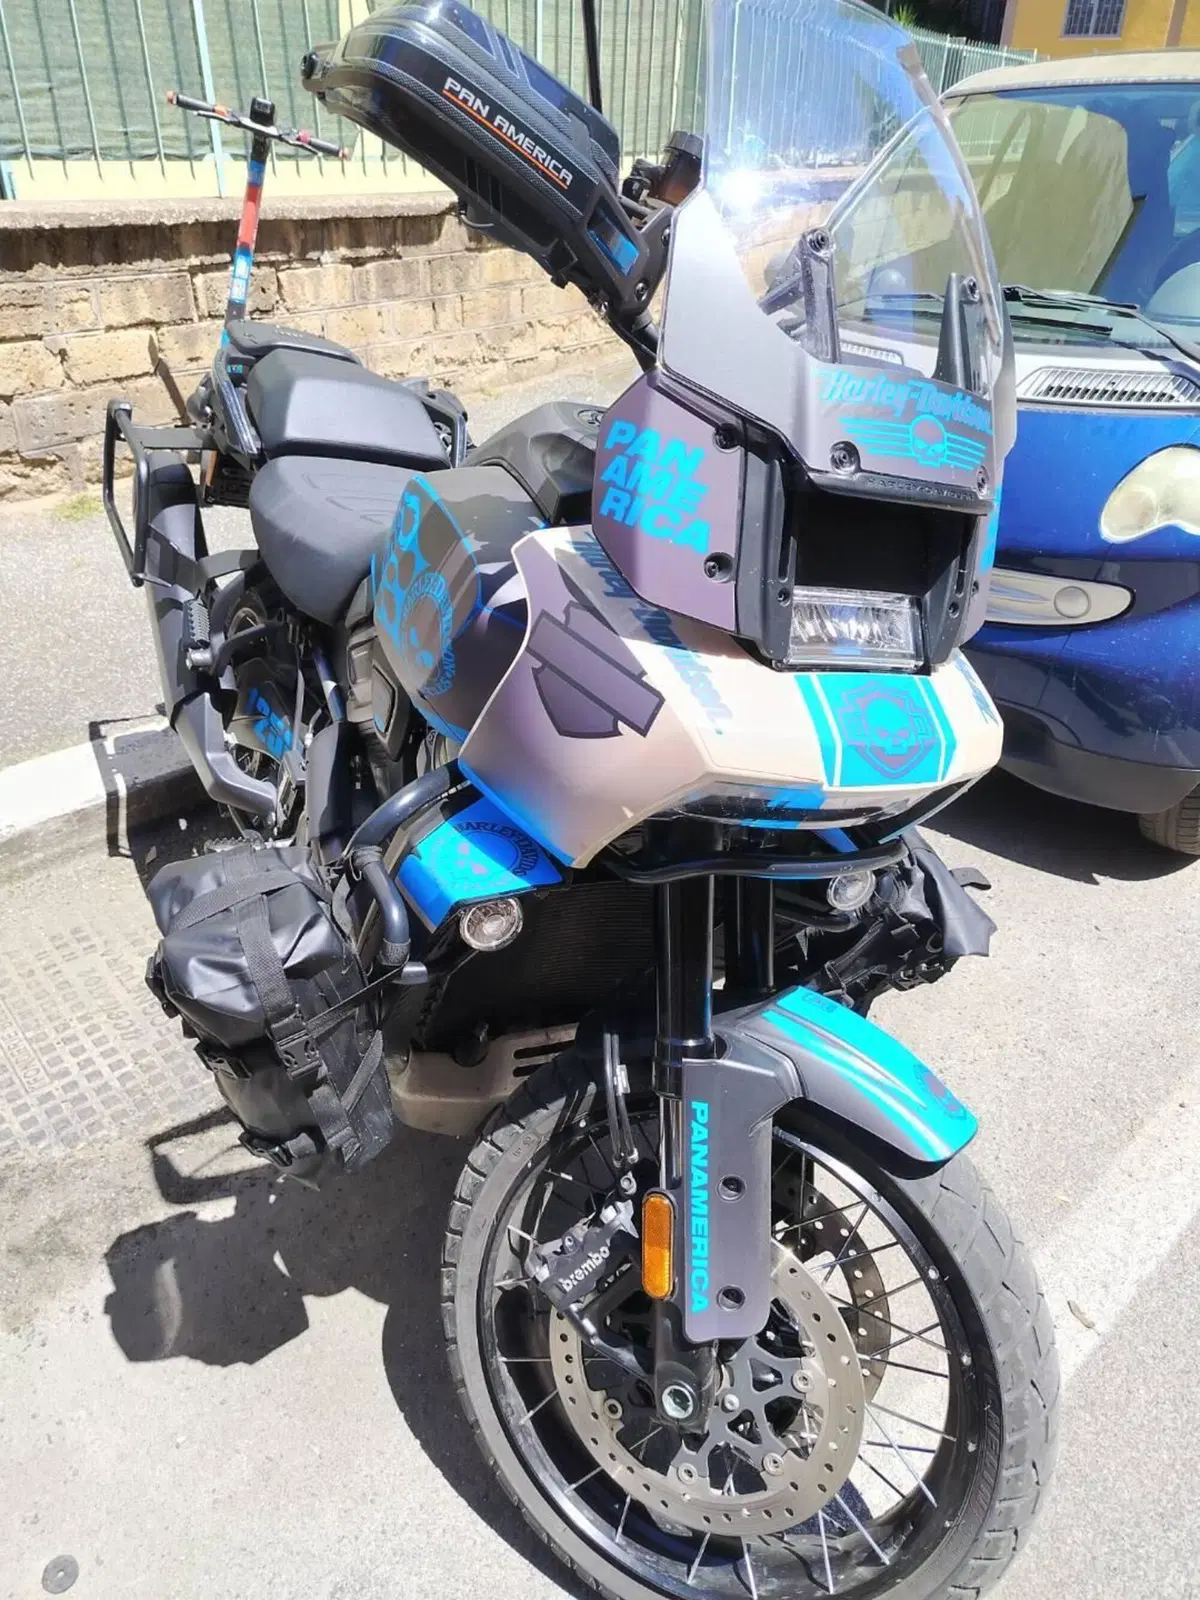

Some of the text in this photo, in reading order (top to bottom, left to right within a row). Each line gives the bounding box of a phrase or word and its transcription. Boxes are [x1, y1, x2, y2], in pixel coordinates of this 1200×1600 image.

[443, 77, 573, 186] PAN AMERICA
[604, 420, 705, 478] PAN
[601, 453, 709, 515] AME
[599, 486, 711, 555] RICA
[690, 1101, 709, 1314] PANAMERICA
[558, 1246, 610, 1292] brembo
